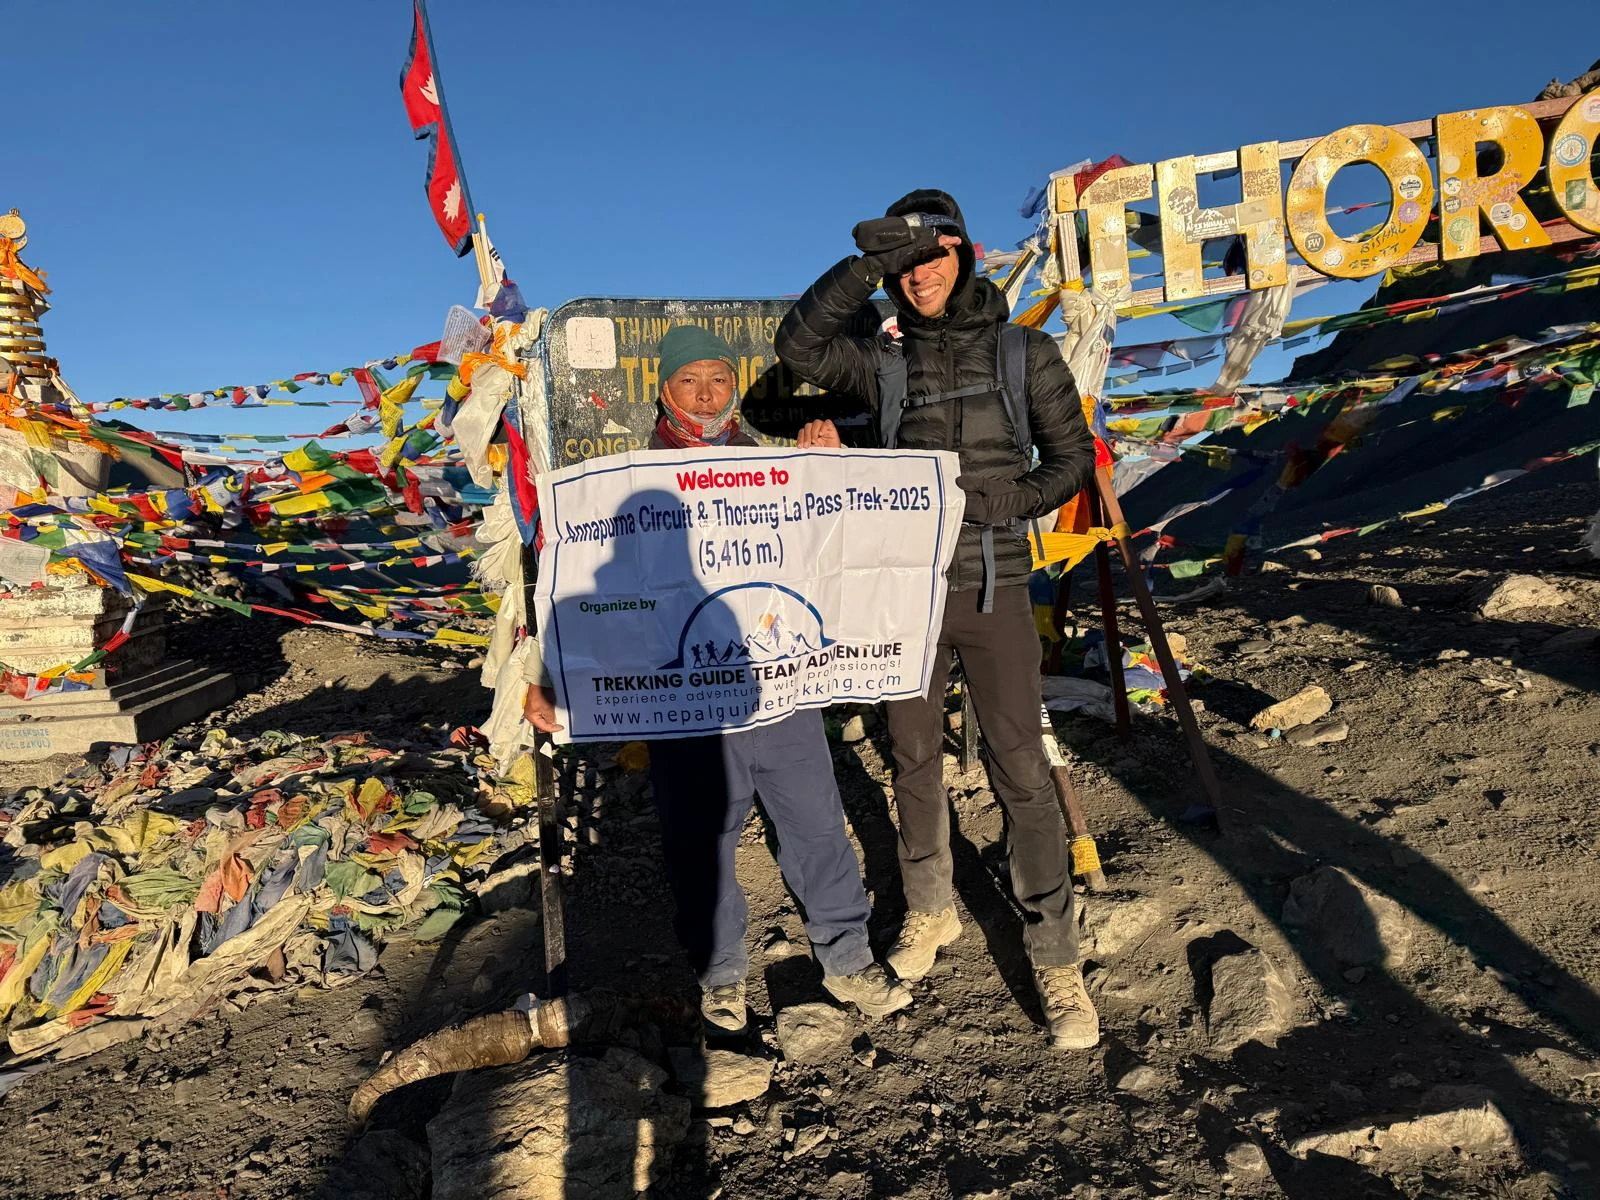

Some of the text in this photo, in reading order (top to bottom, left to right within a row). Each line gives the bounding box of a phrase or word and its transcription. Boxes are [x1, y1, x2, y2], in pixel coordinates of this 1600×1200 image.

[715, 316, 743, 345] FOR
[676, 466, 789, 491] Welcome to
[564, 486, 931, 547] Annapurna Circuit & Thorong La Pass Trek-2025
[698, 533, 784, 575] (5,416 m.)
[579, 598, 656, 615] Organize by
[592, 642, 902, 692] TREKKING GUIDE TEAM ADVENTURE
[596, 691, 677, 707] Experience
[686, 686, 763, 702] adventure
